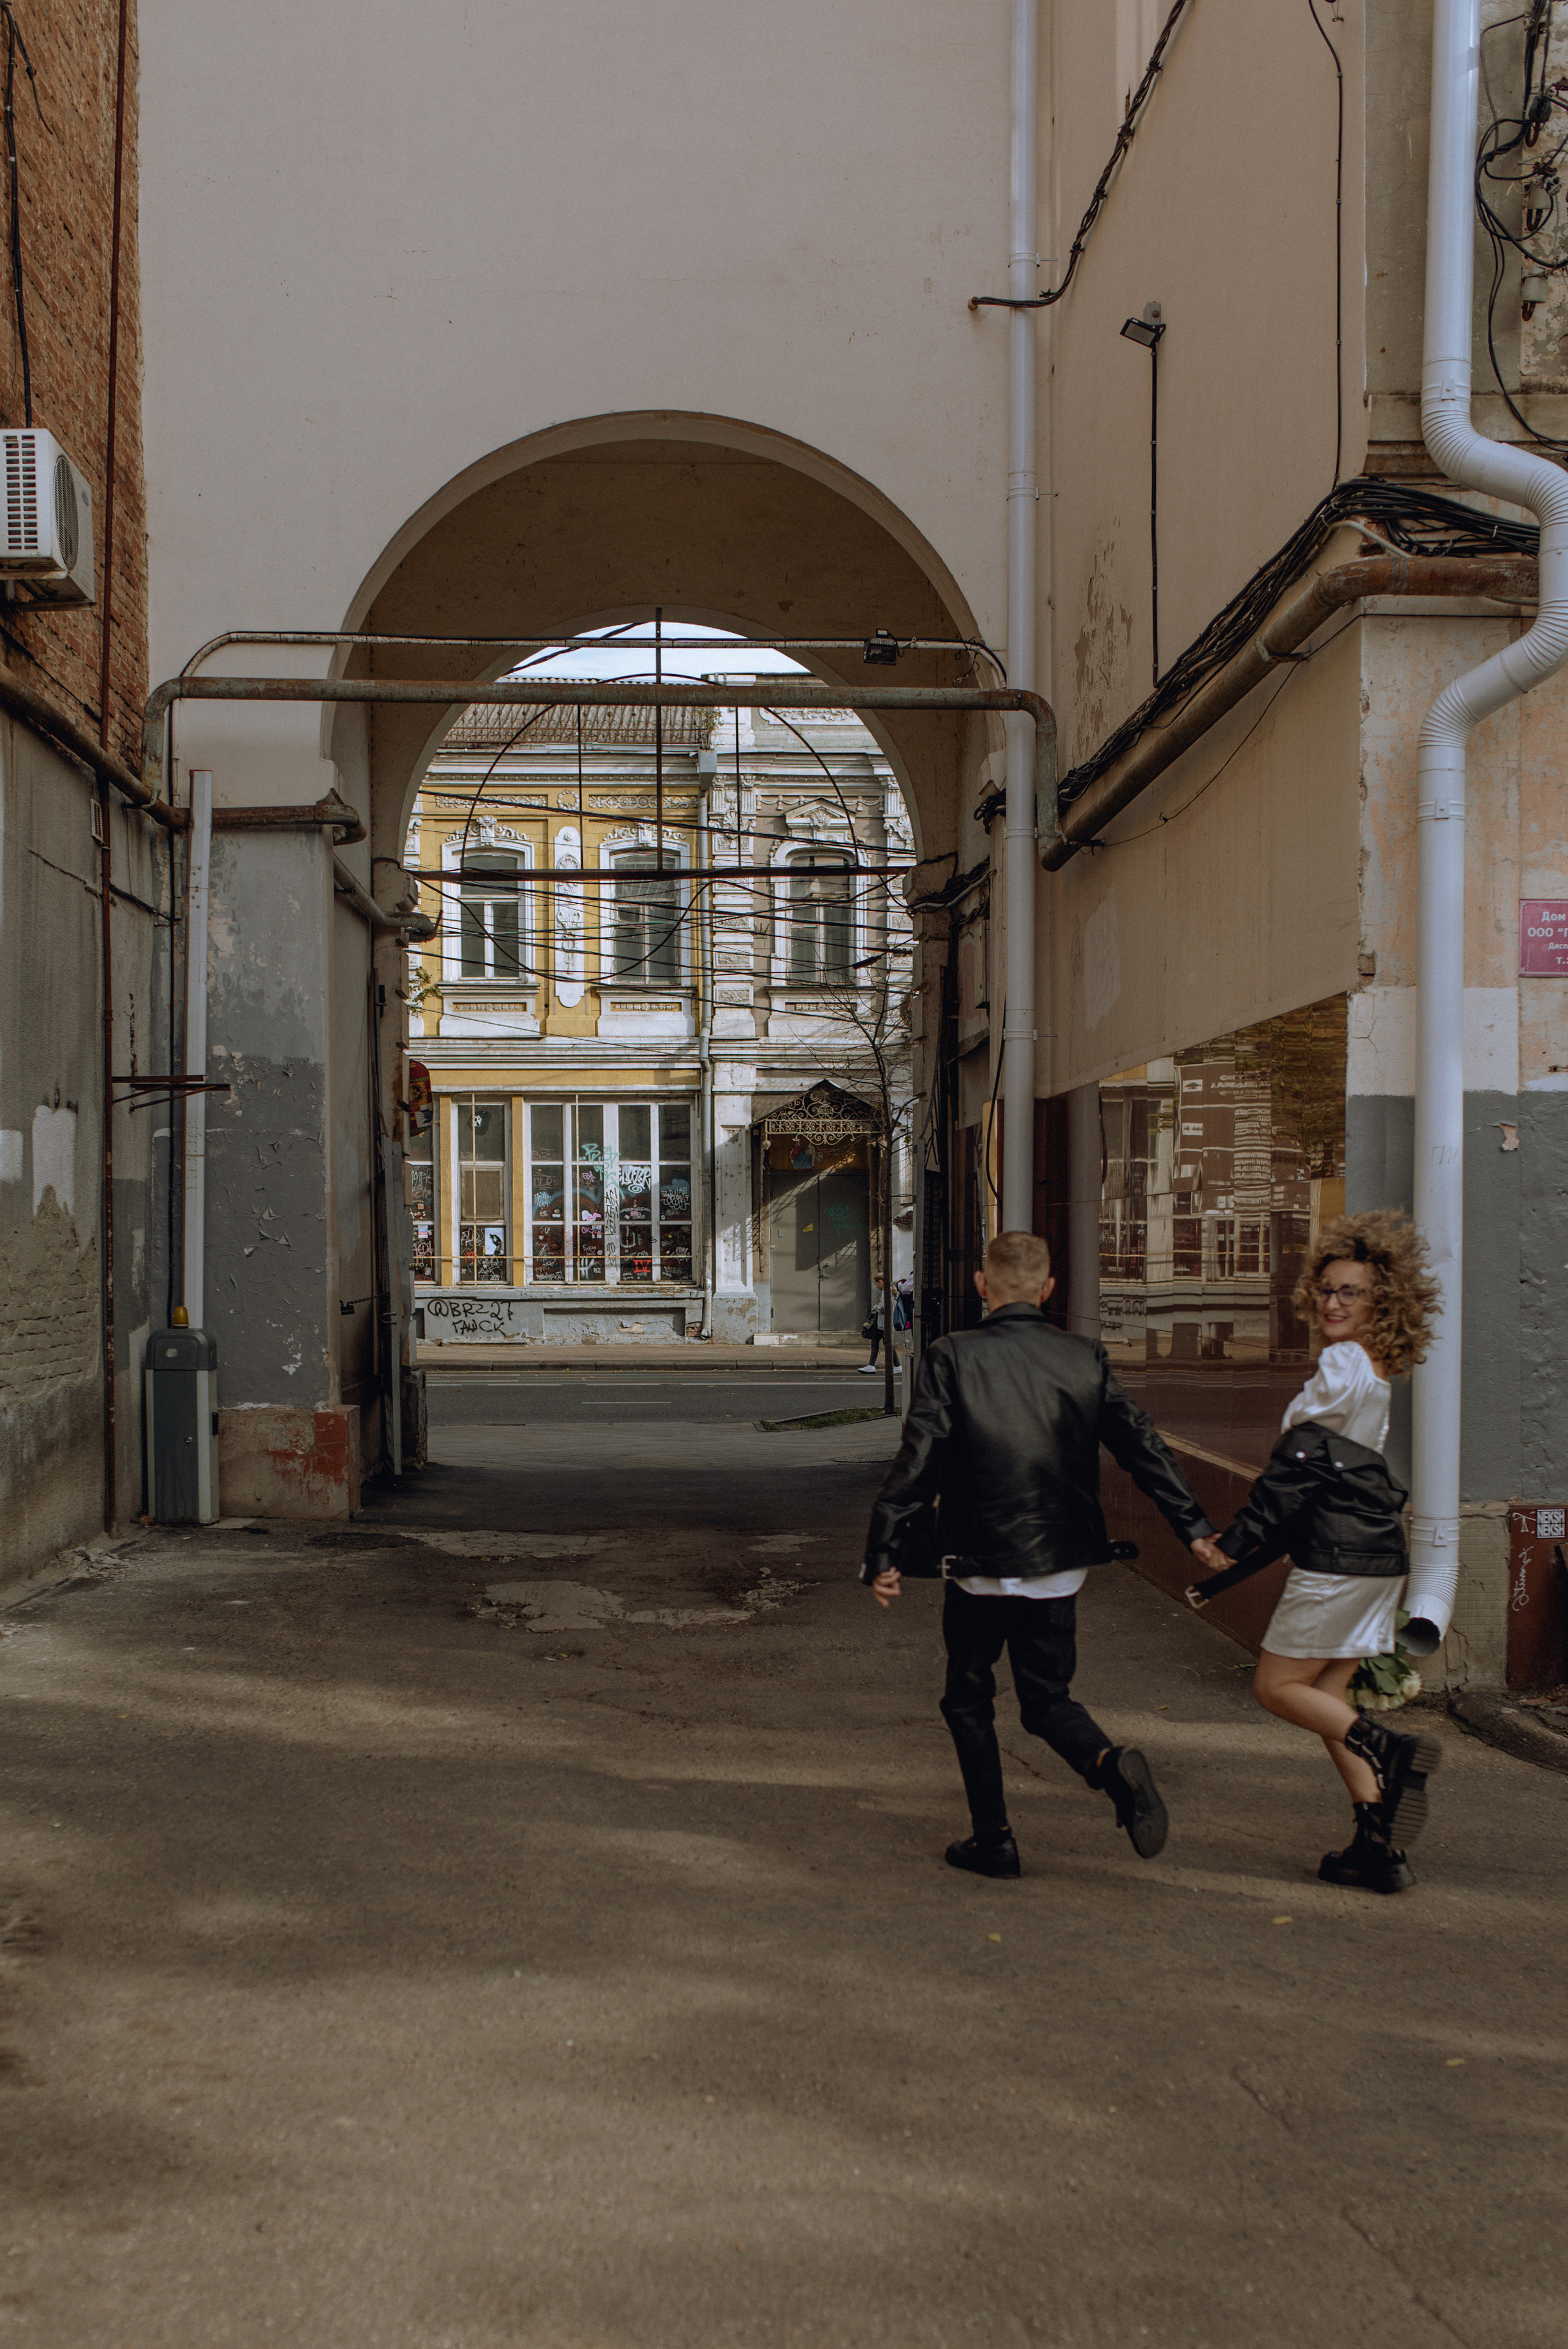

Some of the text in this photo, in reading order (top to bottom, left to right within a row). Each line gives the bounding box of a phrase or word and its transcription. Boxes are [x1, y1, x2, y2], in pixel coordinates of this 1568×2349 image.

[1541, 911, 1566, 923] Дом
[1528, 927, 1554, 937] ООО
[1537, 1511, 1565, 1524] NEKSH
[1537, 1524, 1565, 1536] NEKSH
